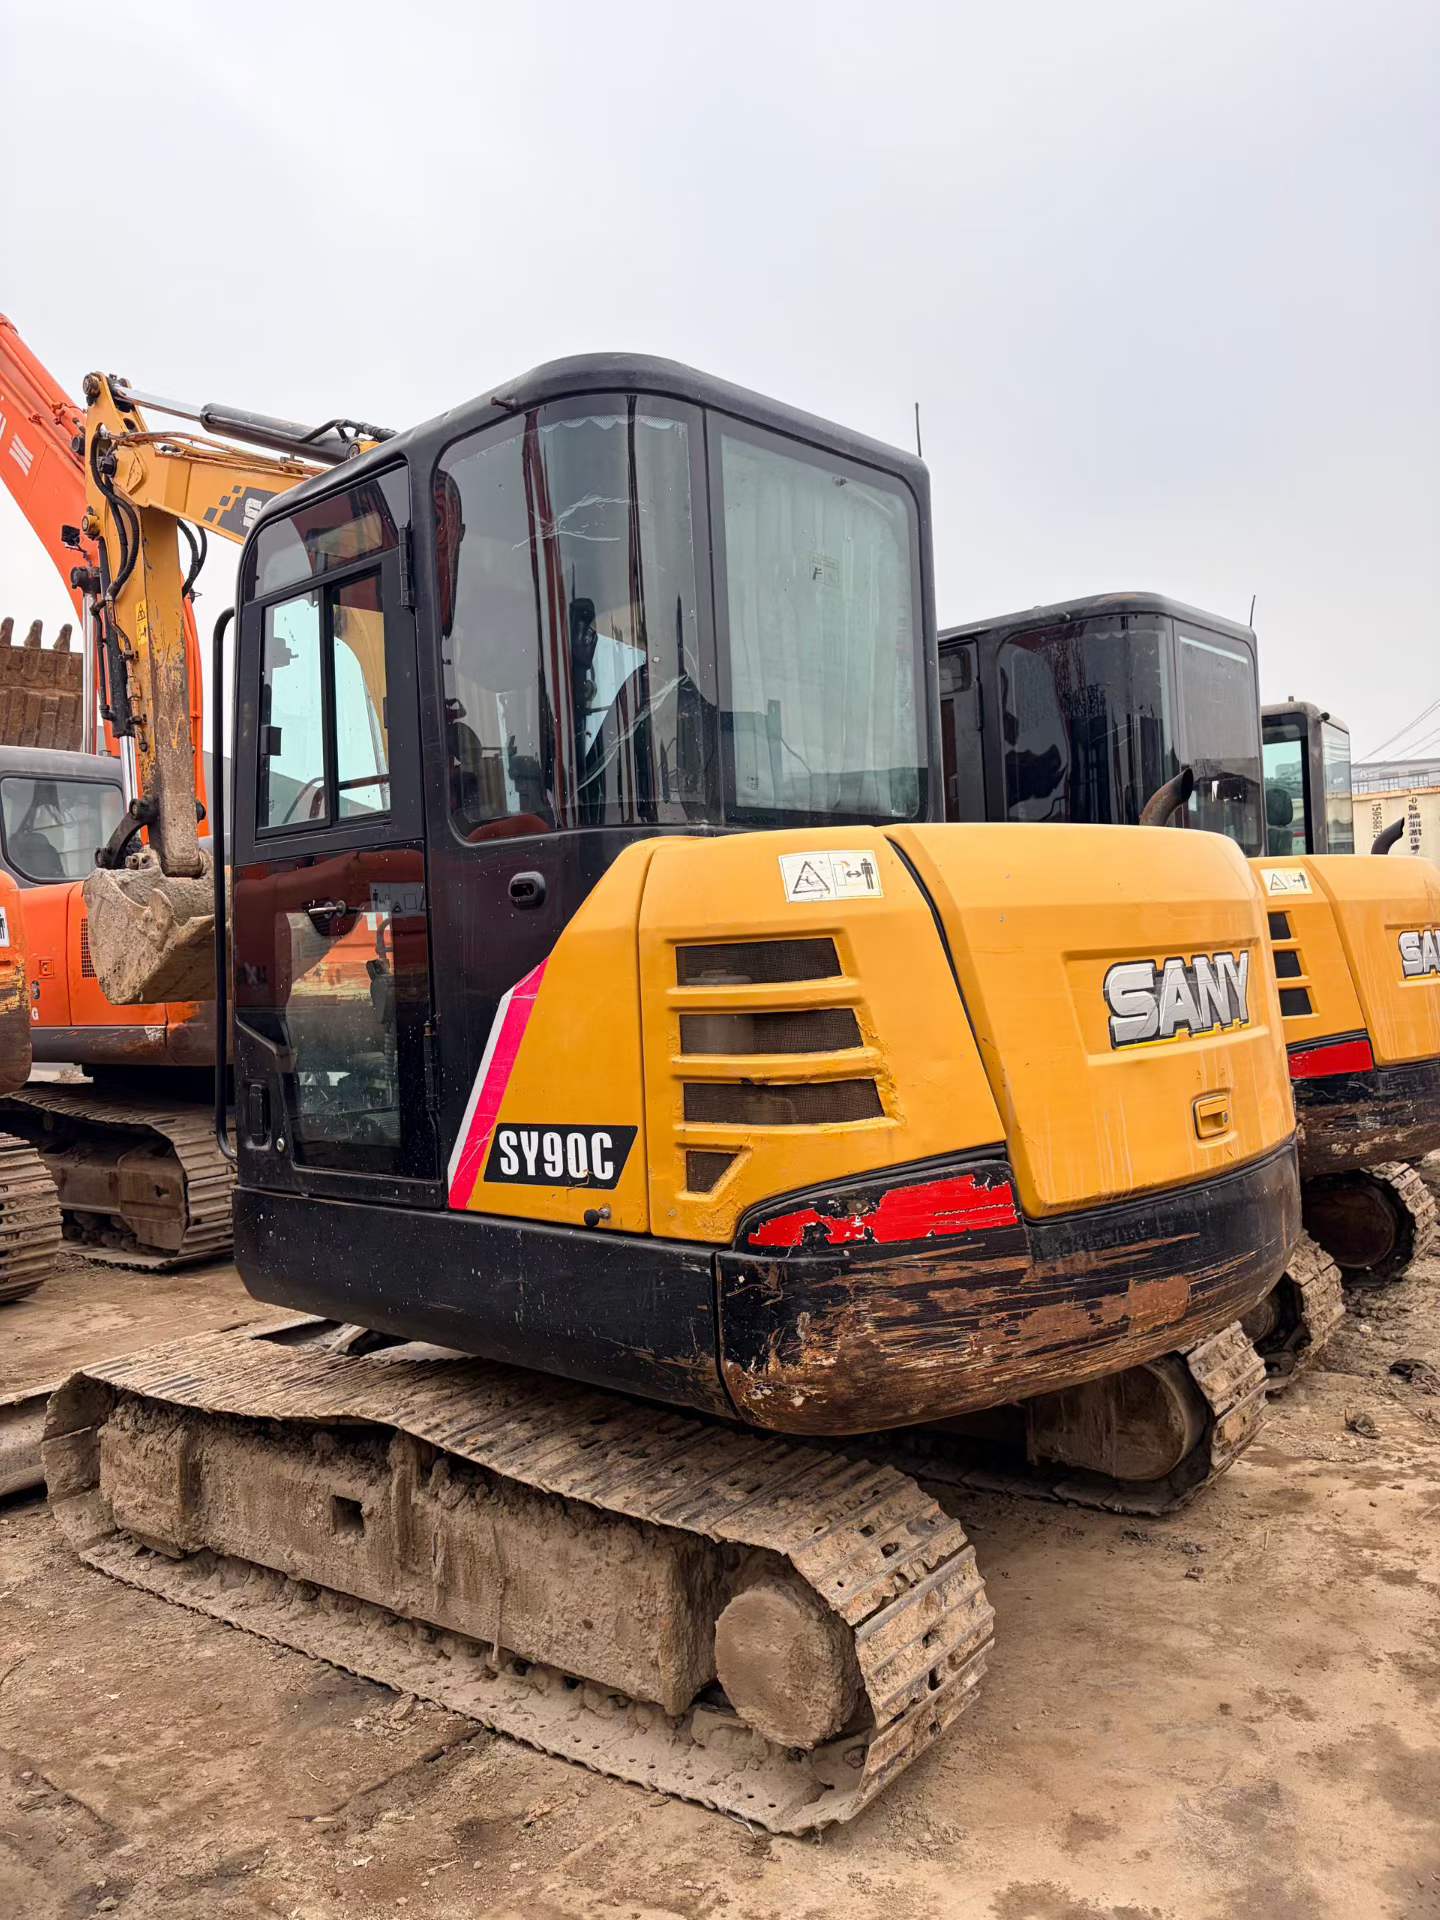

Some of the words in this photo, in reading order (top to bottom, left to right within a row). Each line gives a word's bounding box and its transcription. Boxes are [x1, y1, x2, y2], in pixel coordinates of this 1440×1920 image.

[1398, 929, 1440, 978] SA
[1103, 950, 1250, 1048] SANY
[499, 1130, 615, 1181] SY90C
